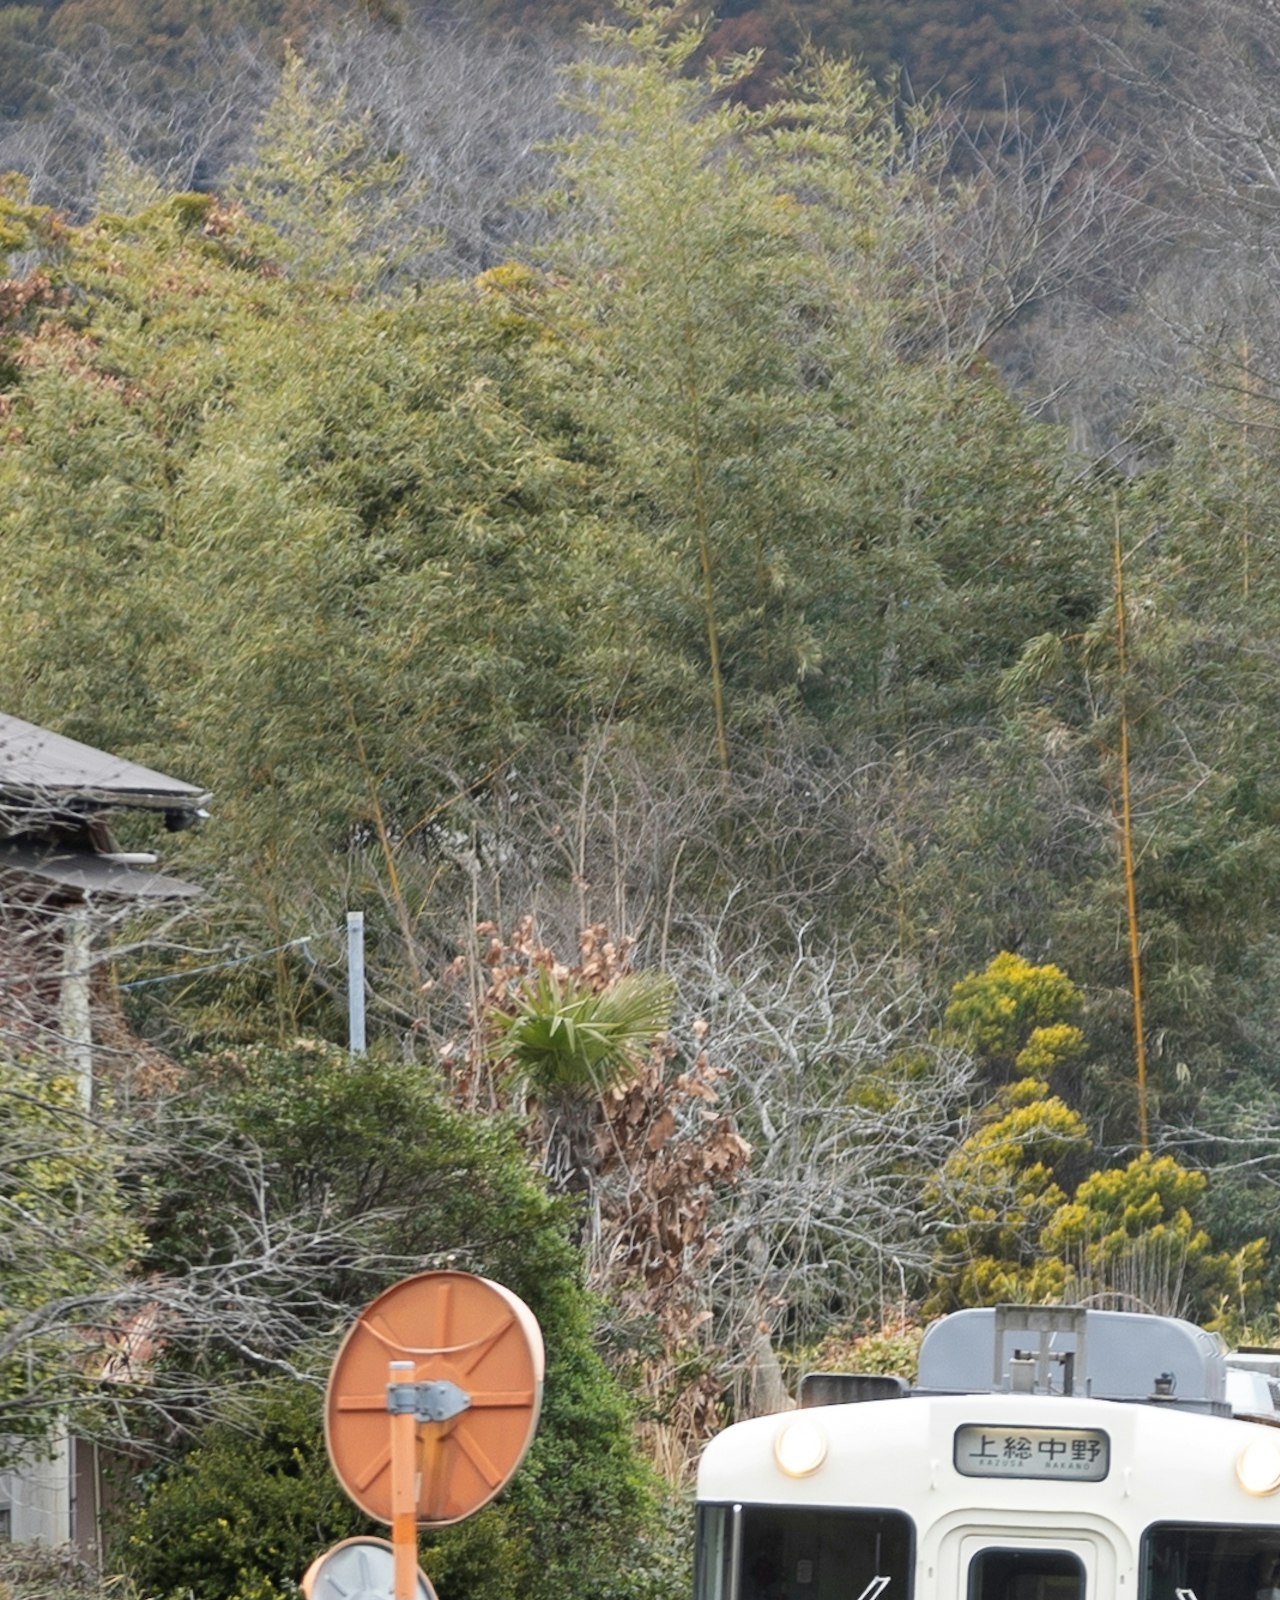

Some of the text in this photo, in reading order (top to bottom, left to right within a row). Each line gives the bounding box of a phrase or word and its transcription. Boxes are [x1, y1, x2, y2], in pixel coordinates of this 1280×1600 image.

[969, 1434, 1101, 1463] 上総中野
[979, 1458, 1090, 1471] KAZUSA NAKANO
